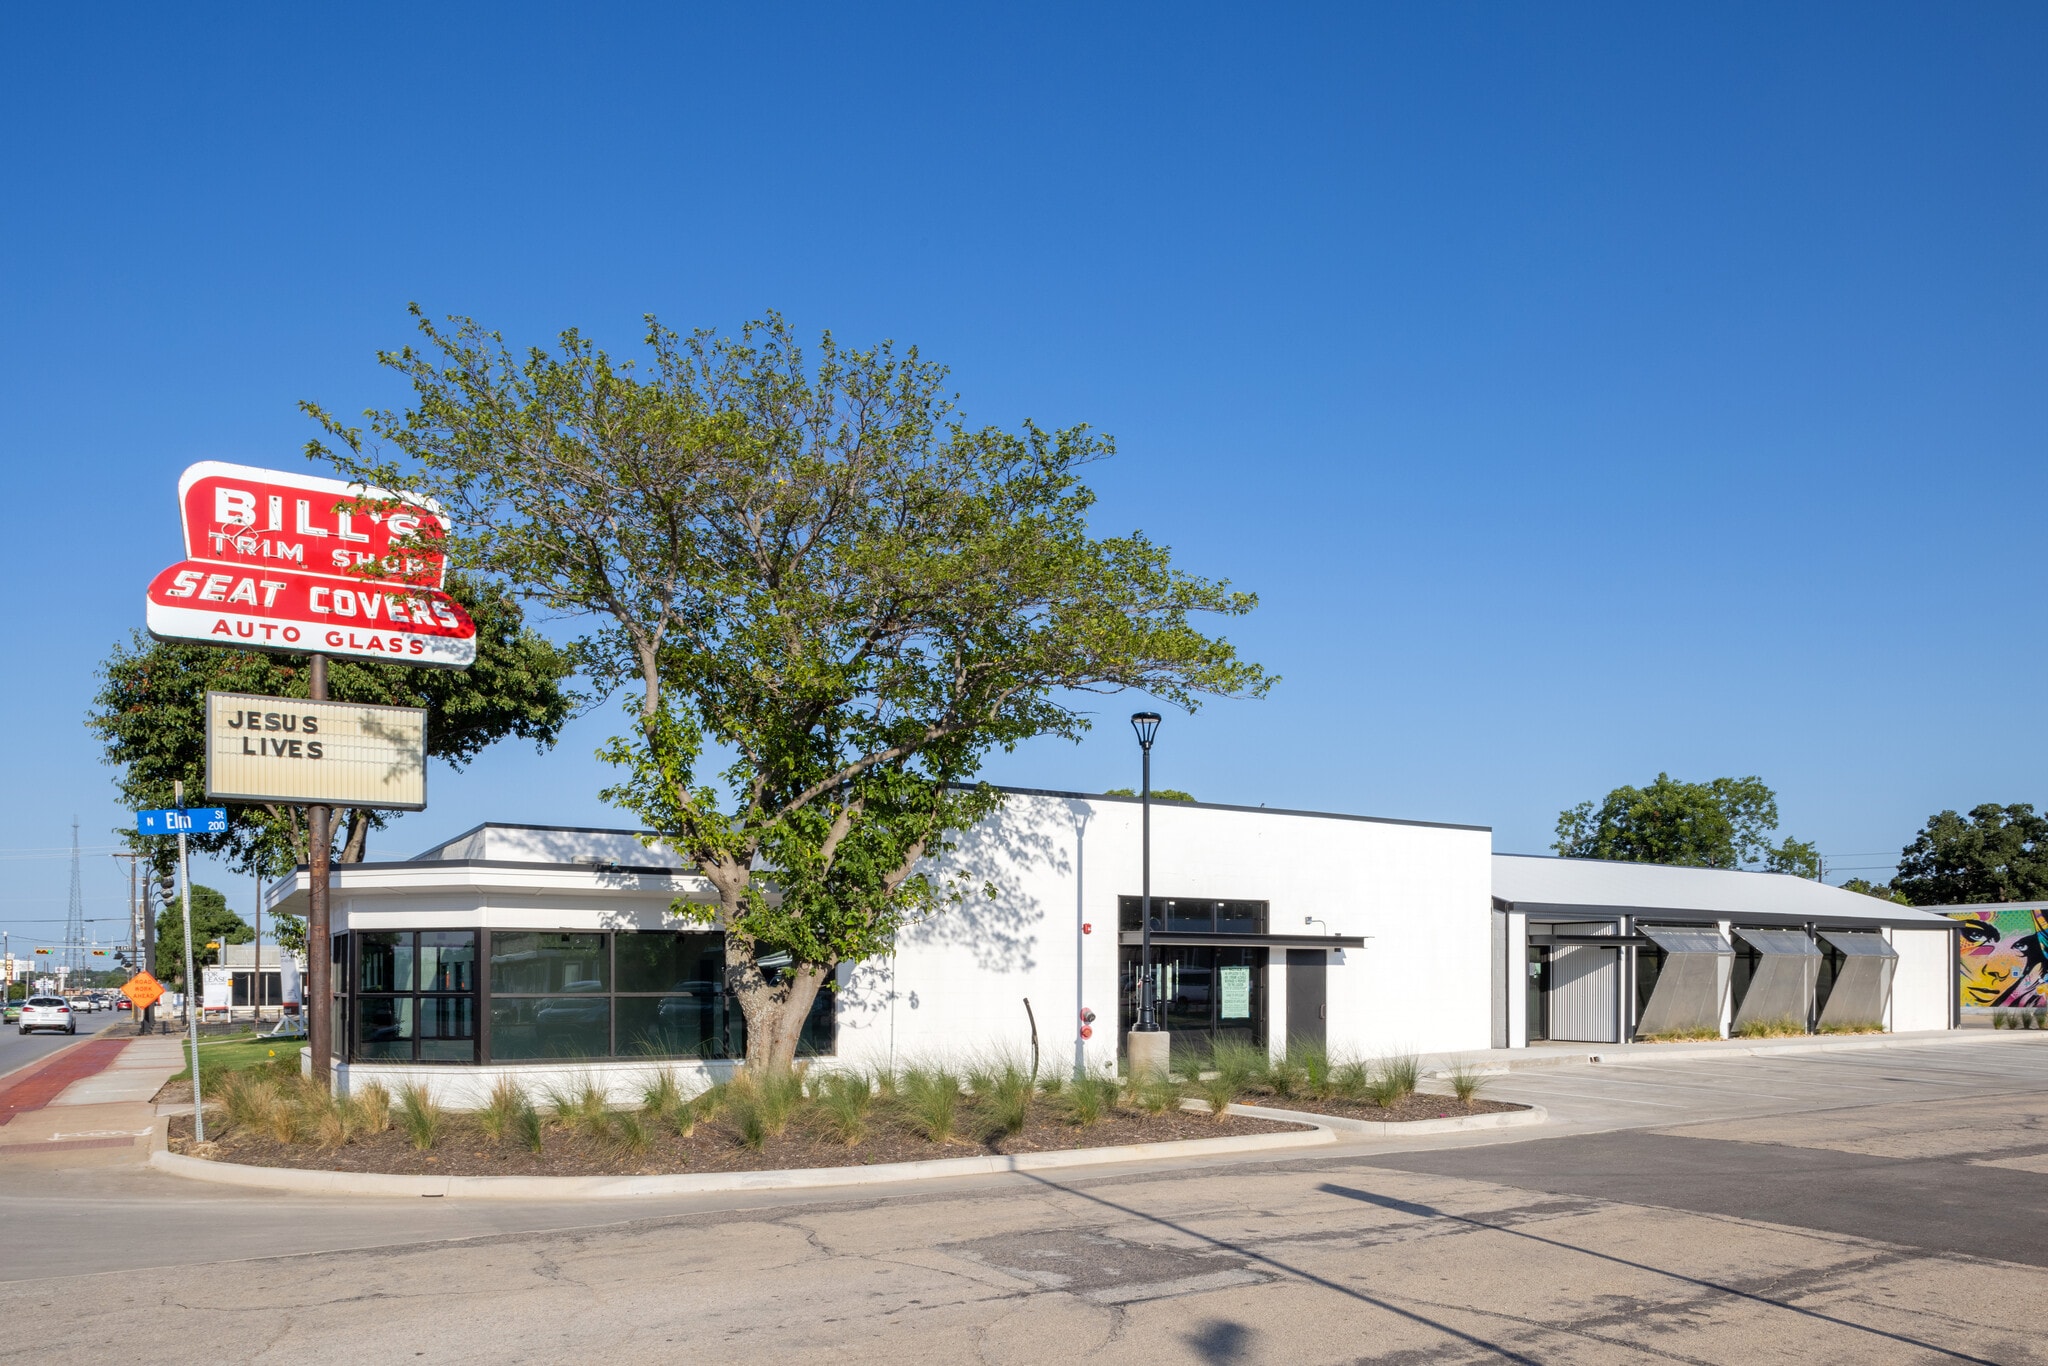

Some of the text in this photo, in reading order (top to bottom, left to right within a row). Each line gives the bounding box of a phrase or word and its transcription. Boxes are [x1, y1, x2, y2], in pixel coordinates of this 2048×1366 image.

[215, 487, 421, 547] BILL'S
[208, 532, 304, 563] TRIM
[165, 570, 459, 628] SEAT COVERS
[212, 619, 424, 654] AUTO GLASS
[228, 710, 318, 733] JESUS
[243, 736, 323, 759] LIVES
[146, 810, 224, 829] N Elm St
[208, 821, 225, 830] 200
